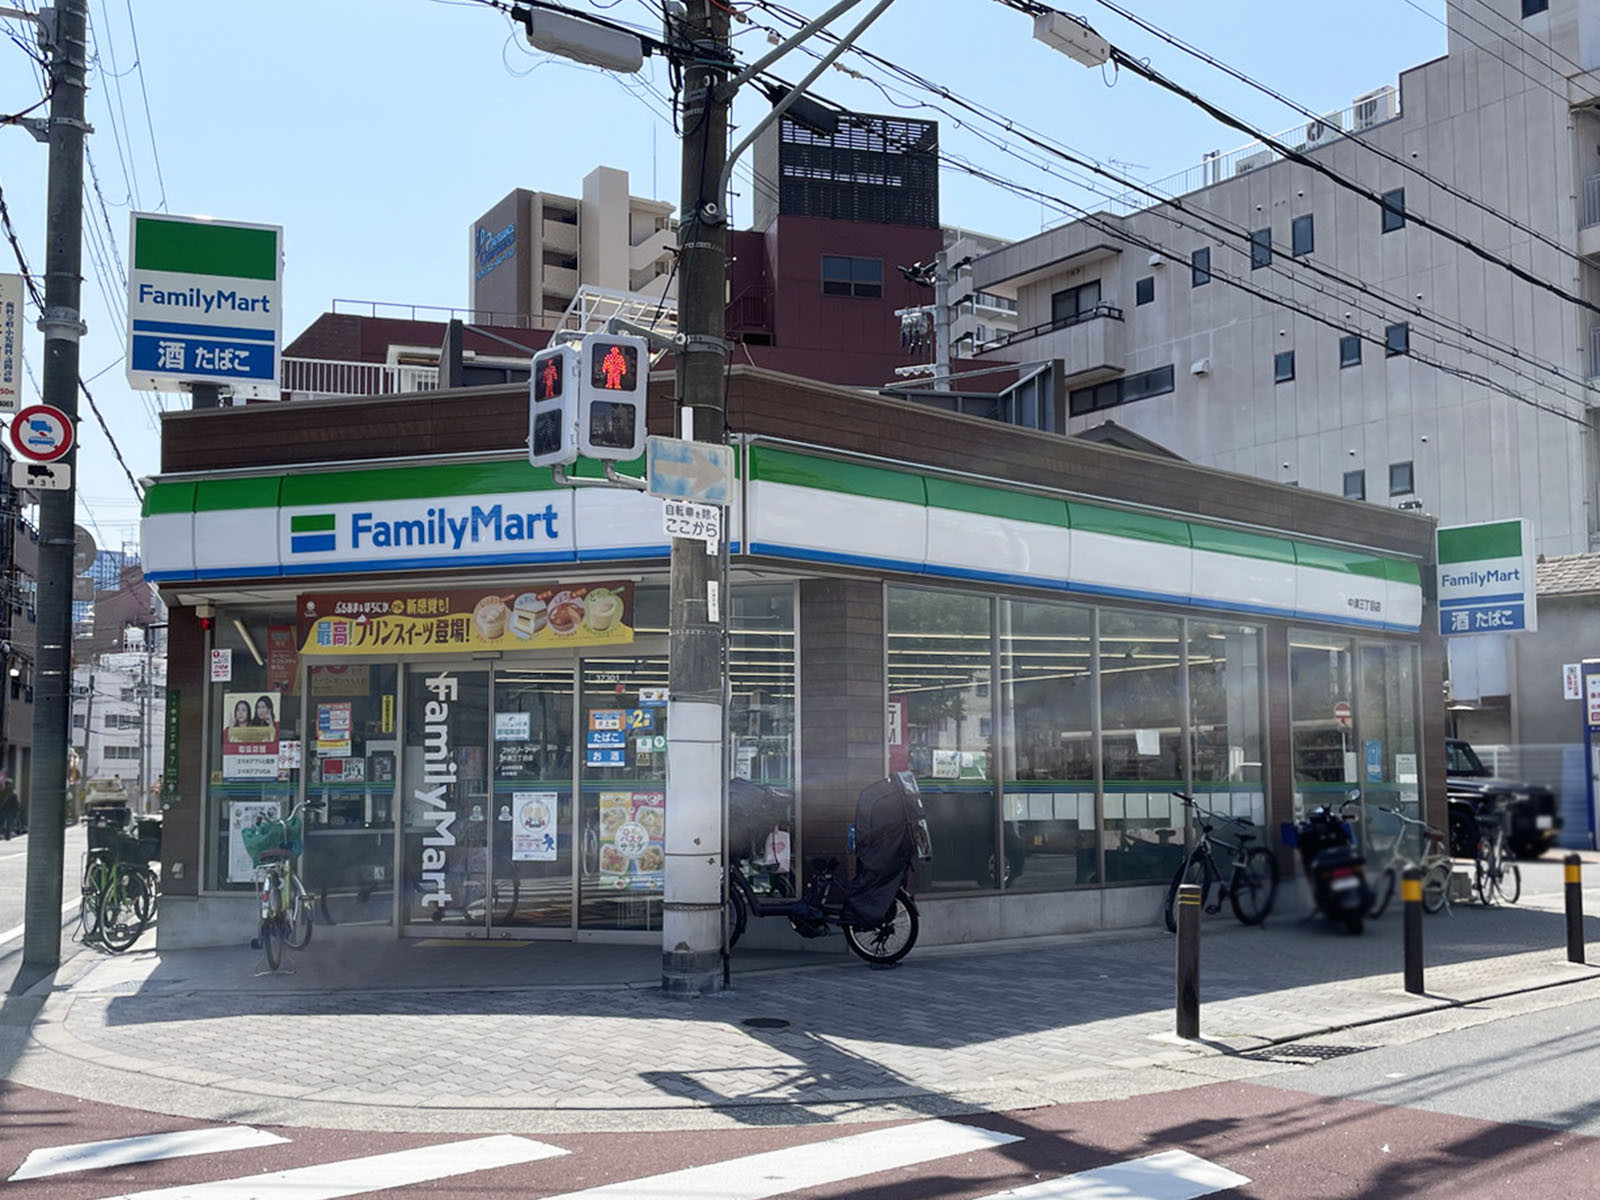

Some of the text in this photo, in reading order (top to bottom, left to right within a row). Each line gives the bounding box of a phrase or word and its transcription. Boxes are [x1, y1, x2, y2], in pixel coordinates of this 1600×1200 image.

[139, 283, 270, 313] FamilyMart
[157, 340, 250, 371] 酒 たばこ
[665, 504, 718, 521] 自転車を除く
[352, 504, 558, 549] FamilyMart
[665, 518, 718, 538] ここから
[1442, 569, 1520, 587] FamilyMart
[1452, 610, 1514, 631] 酒 たばこ
[593, 733, 620, 743] たばこ
[414, 677, 459, 908] FamilyMart
